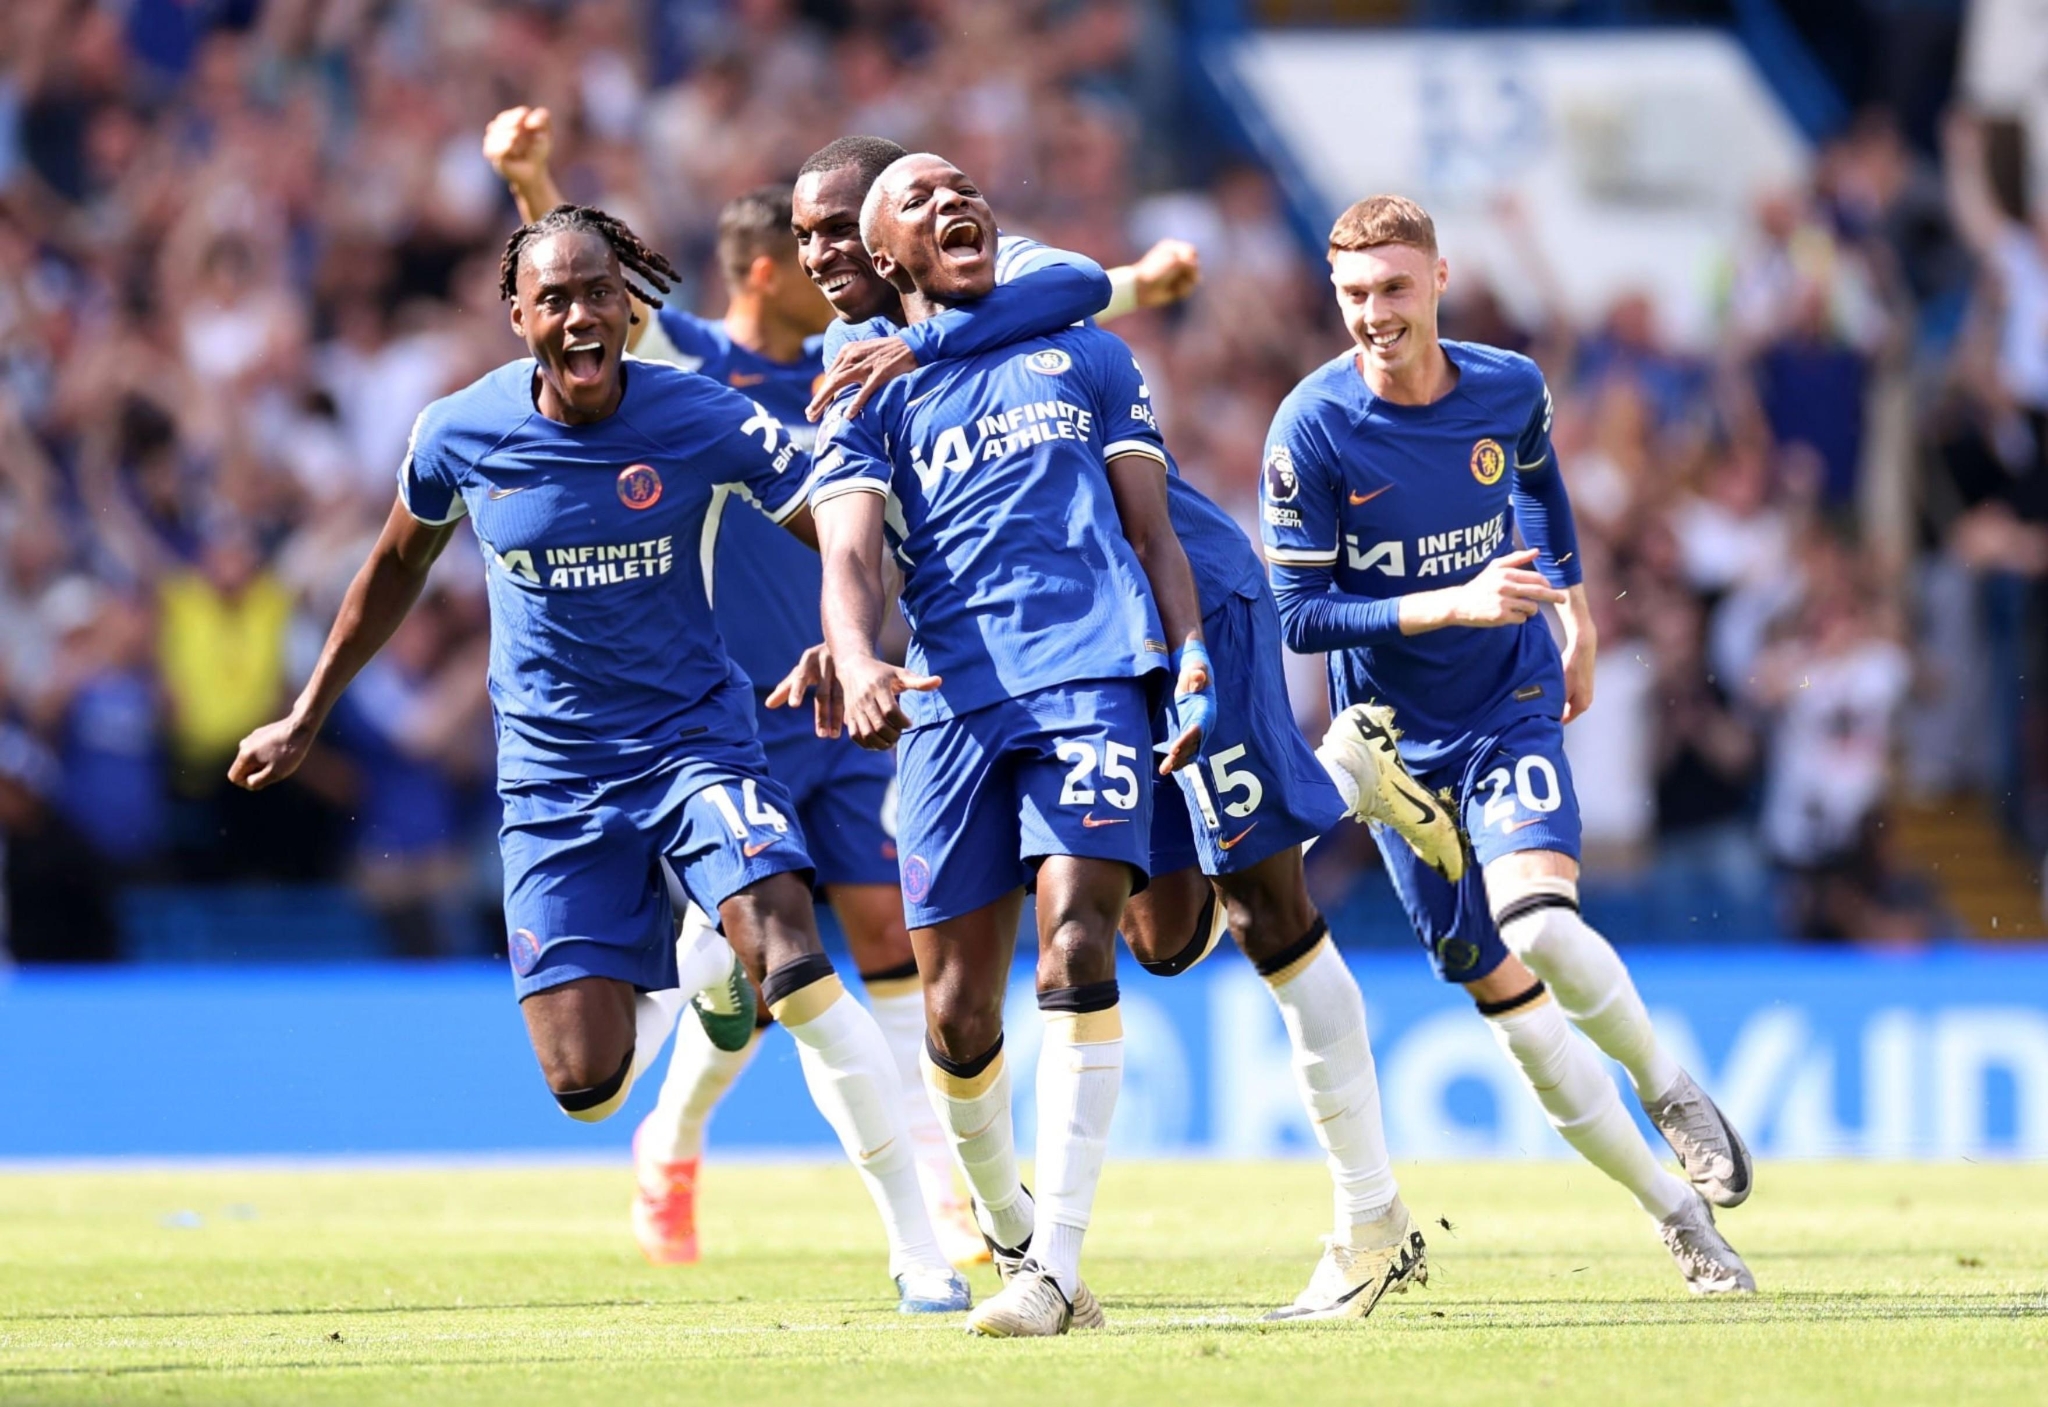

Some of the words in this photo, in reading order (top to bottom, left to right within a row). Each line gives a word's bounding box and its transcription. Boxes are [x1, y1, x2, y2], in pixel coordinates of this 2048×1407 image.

[976, 400, 1093, 438] INFINITE
[982, 421, 1088, 462] ATHLE
[546, 536, 672, 565] INFINITE
[550, 554, 673, 588] ATHLETE
[1056, 740, 1138, 810] 25
[1182, 743, 1262, 829] 15
[1476, 754, 1561, 828] 20
[701, 778, 788, 839] 14
